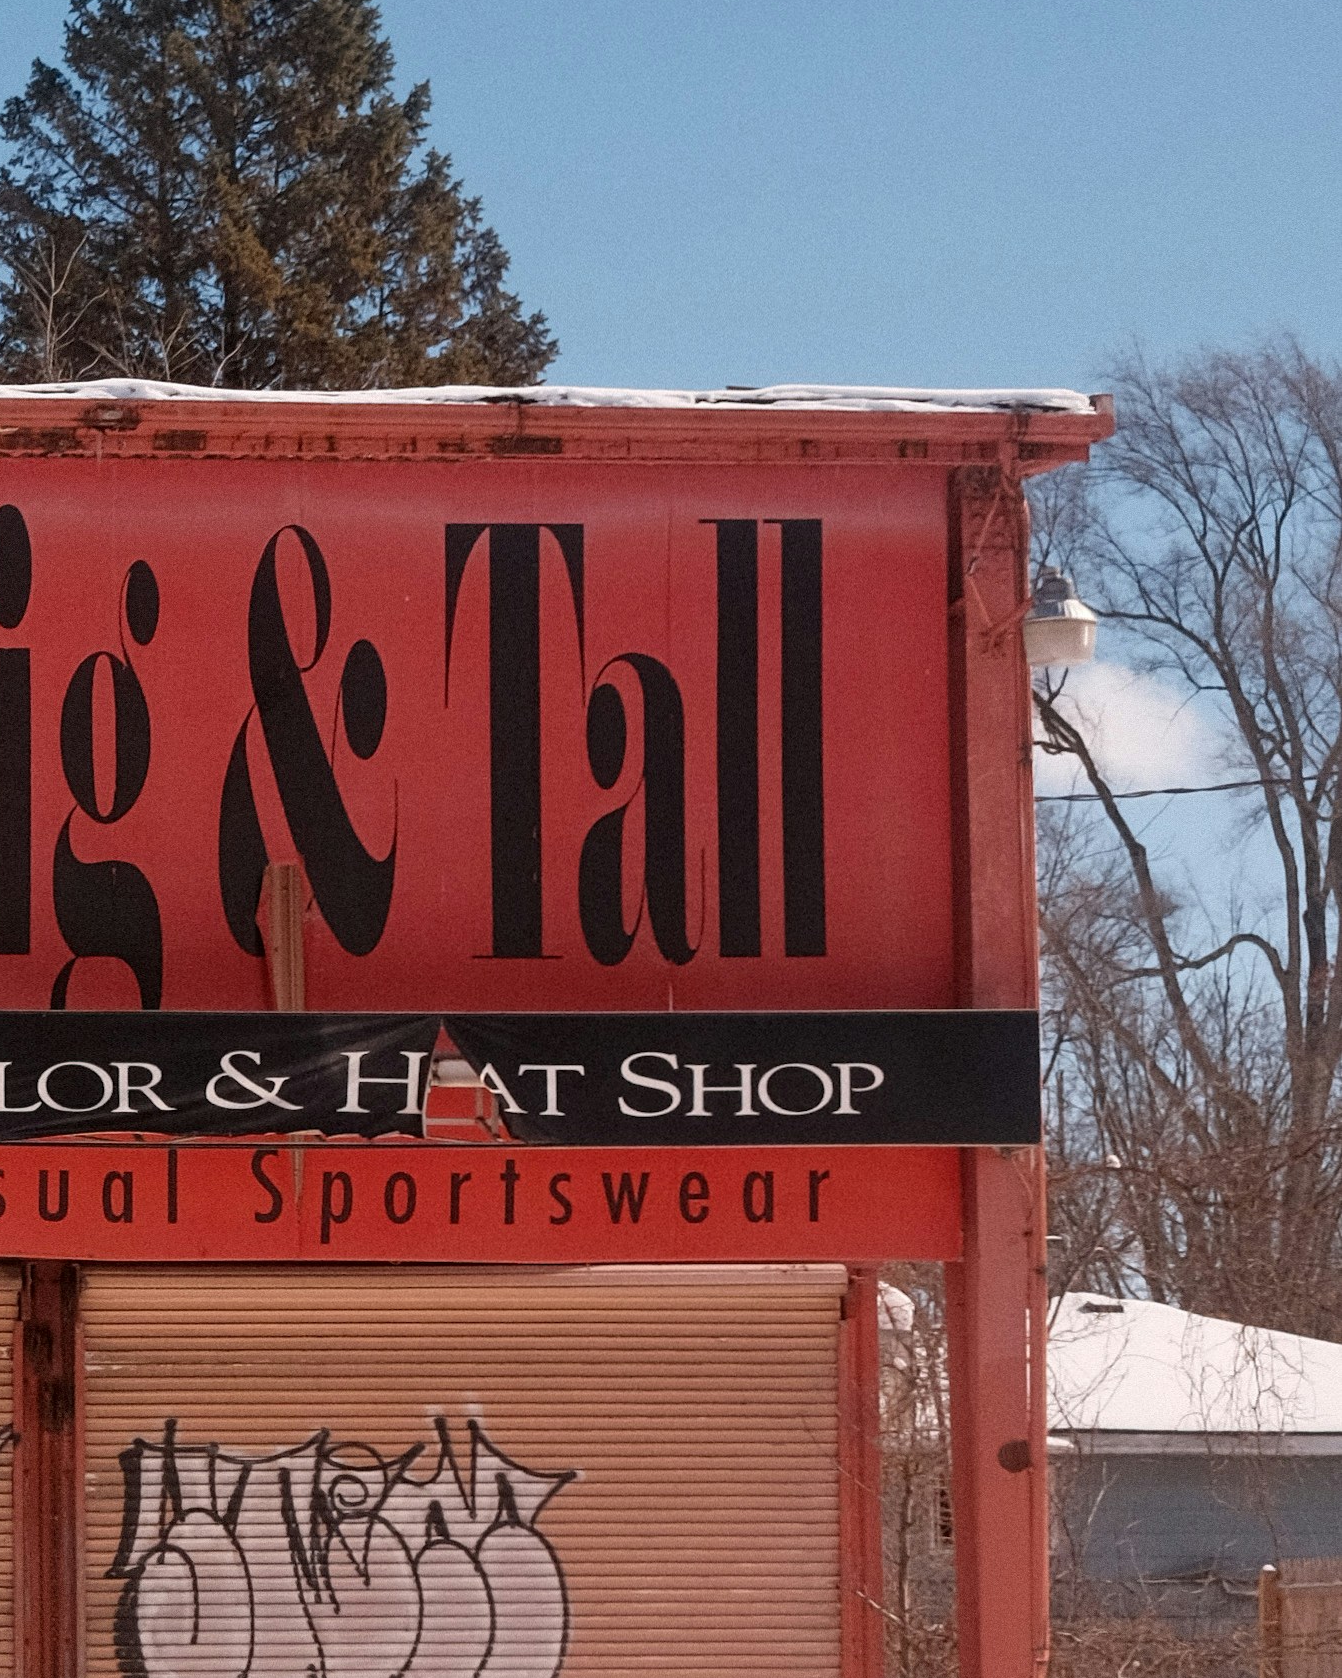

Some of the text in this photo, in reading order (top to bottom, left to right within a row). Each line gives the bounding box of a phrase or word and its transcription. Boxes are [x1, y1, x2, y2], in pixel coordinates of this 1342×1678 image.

[219, 524, 398, 957] &
[445, 518, 827, 966] Tall
[205, 1050, 303, 1111] &
[618, 1051, 885, 1118] SHOP
[252, 1150, 830, 1244] Sportswear
